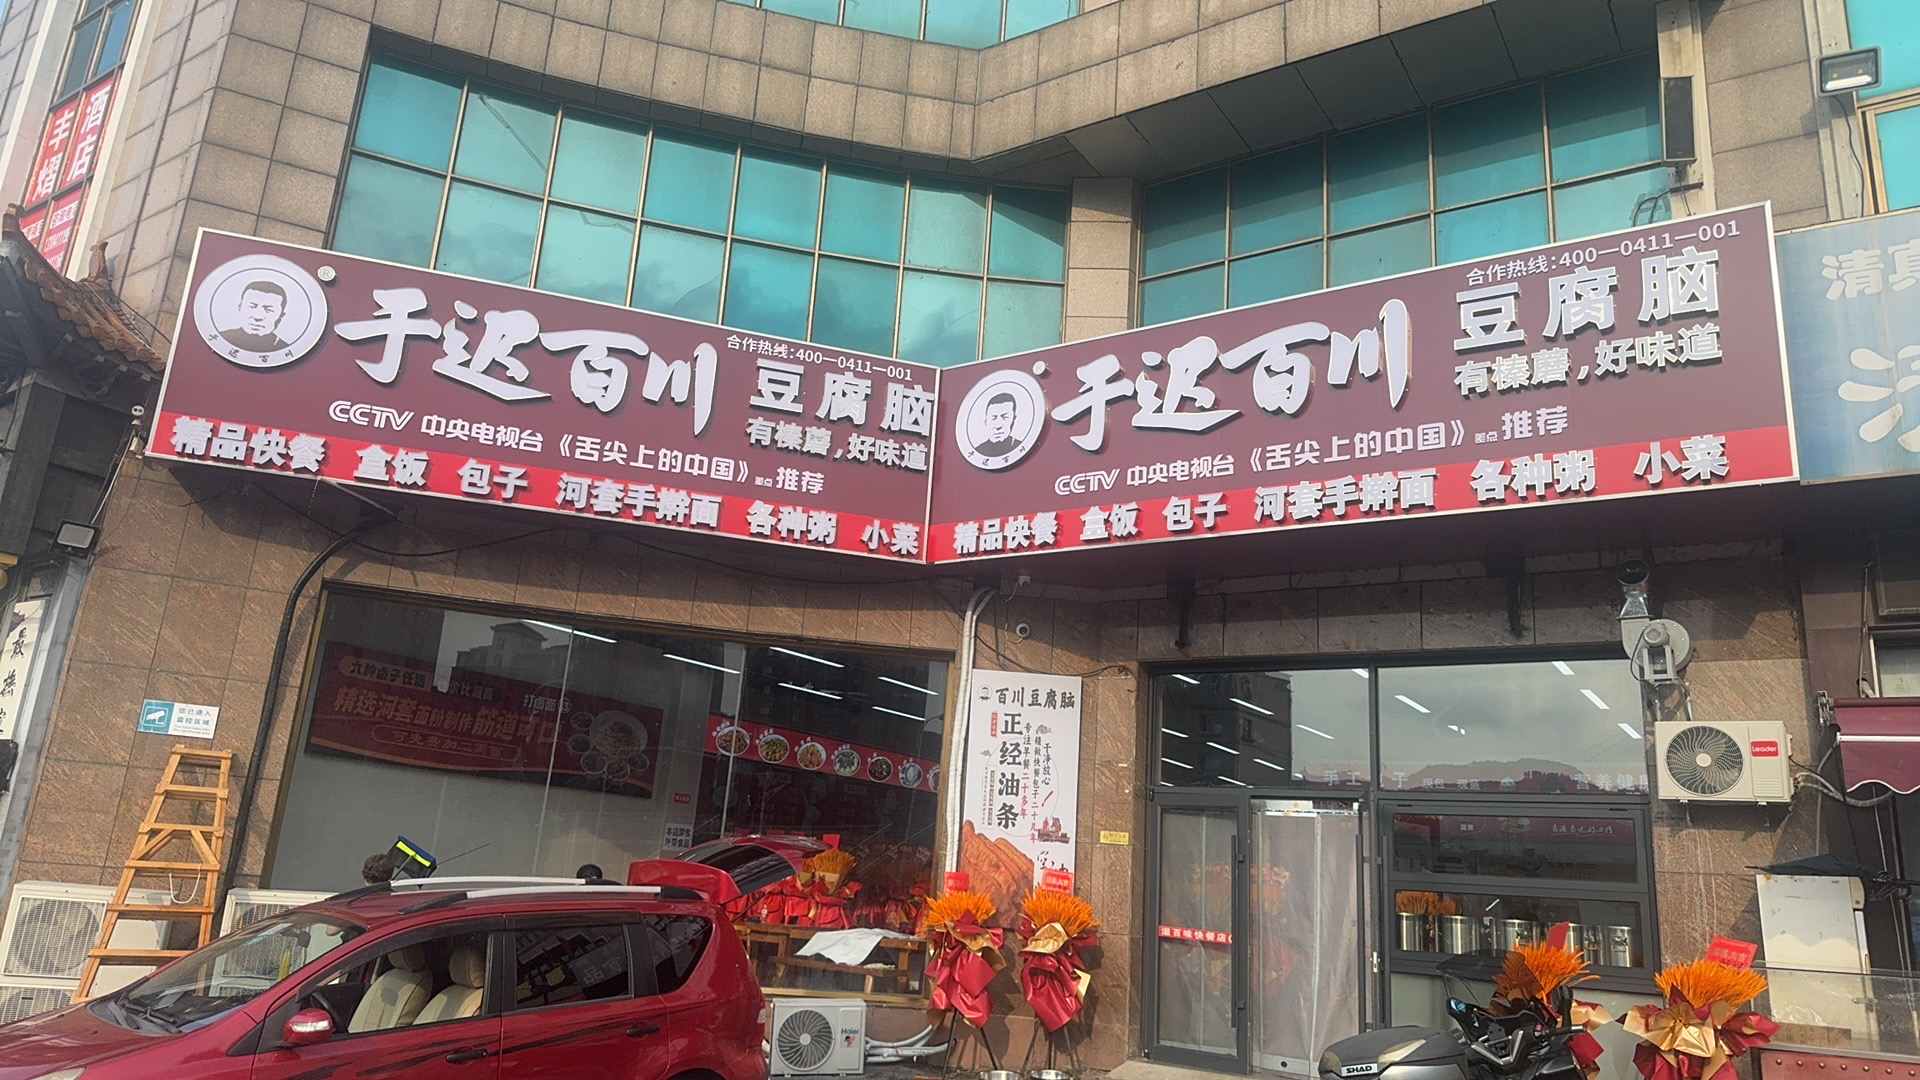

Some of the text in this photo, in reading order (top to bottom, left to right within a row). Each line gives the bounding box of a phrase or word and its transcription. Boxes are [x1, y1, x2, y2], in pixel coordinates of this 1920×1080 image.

[1454, 246, 1720, 351] 豆腐脑
[334, 288, 718, 437] 于迟百川
[750, 358, 935, 438] 豆腐脑
[1051, 298, 1412, 451] 于迟百川
[170, 416, 921, 556] 精品快餐 盒饭 包子 河套手擀面 各种粥 小菜
[329, 400, 414, 431] CCTV
[421, 414, 544, 453] 中央电视台
[559, 433, 749, 484] 《舌尖上的中国》
[776, 466, 824, 495] 推荐
[953, 434, 1731, 554] 精品快餐 盒饭 包子 河套手擀面 各种粥 小菜
[1055, 467, 1121, 496] CCTV
[1127, 454, 1235, 487] 中央电视台
[1250, 419, 1466, 472] 《舌尖上的中国》
[1501, 405, 1568, 441] 推荐
[996, 686, 1075, 710] 百川豆腐脑
[1751, 743, 1777, 752] Leader
[996, 712, 1023, 830] 正经油条
